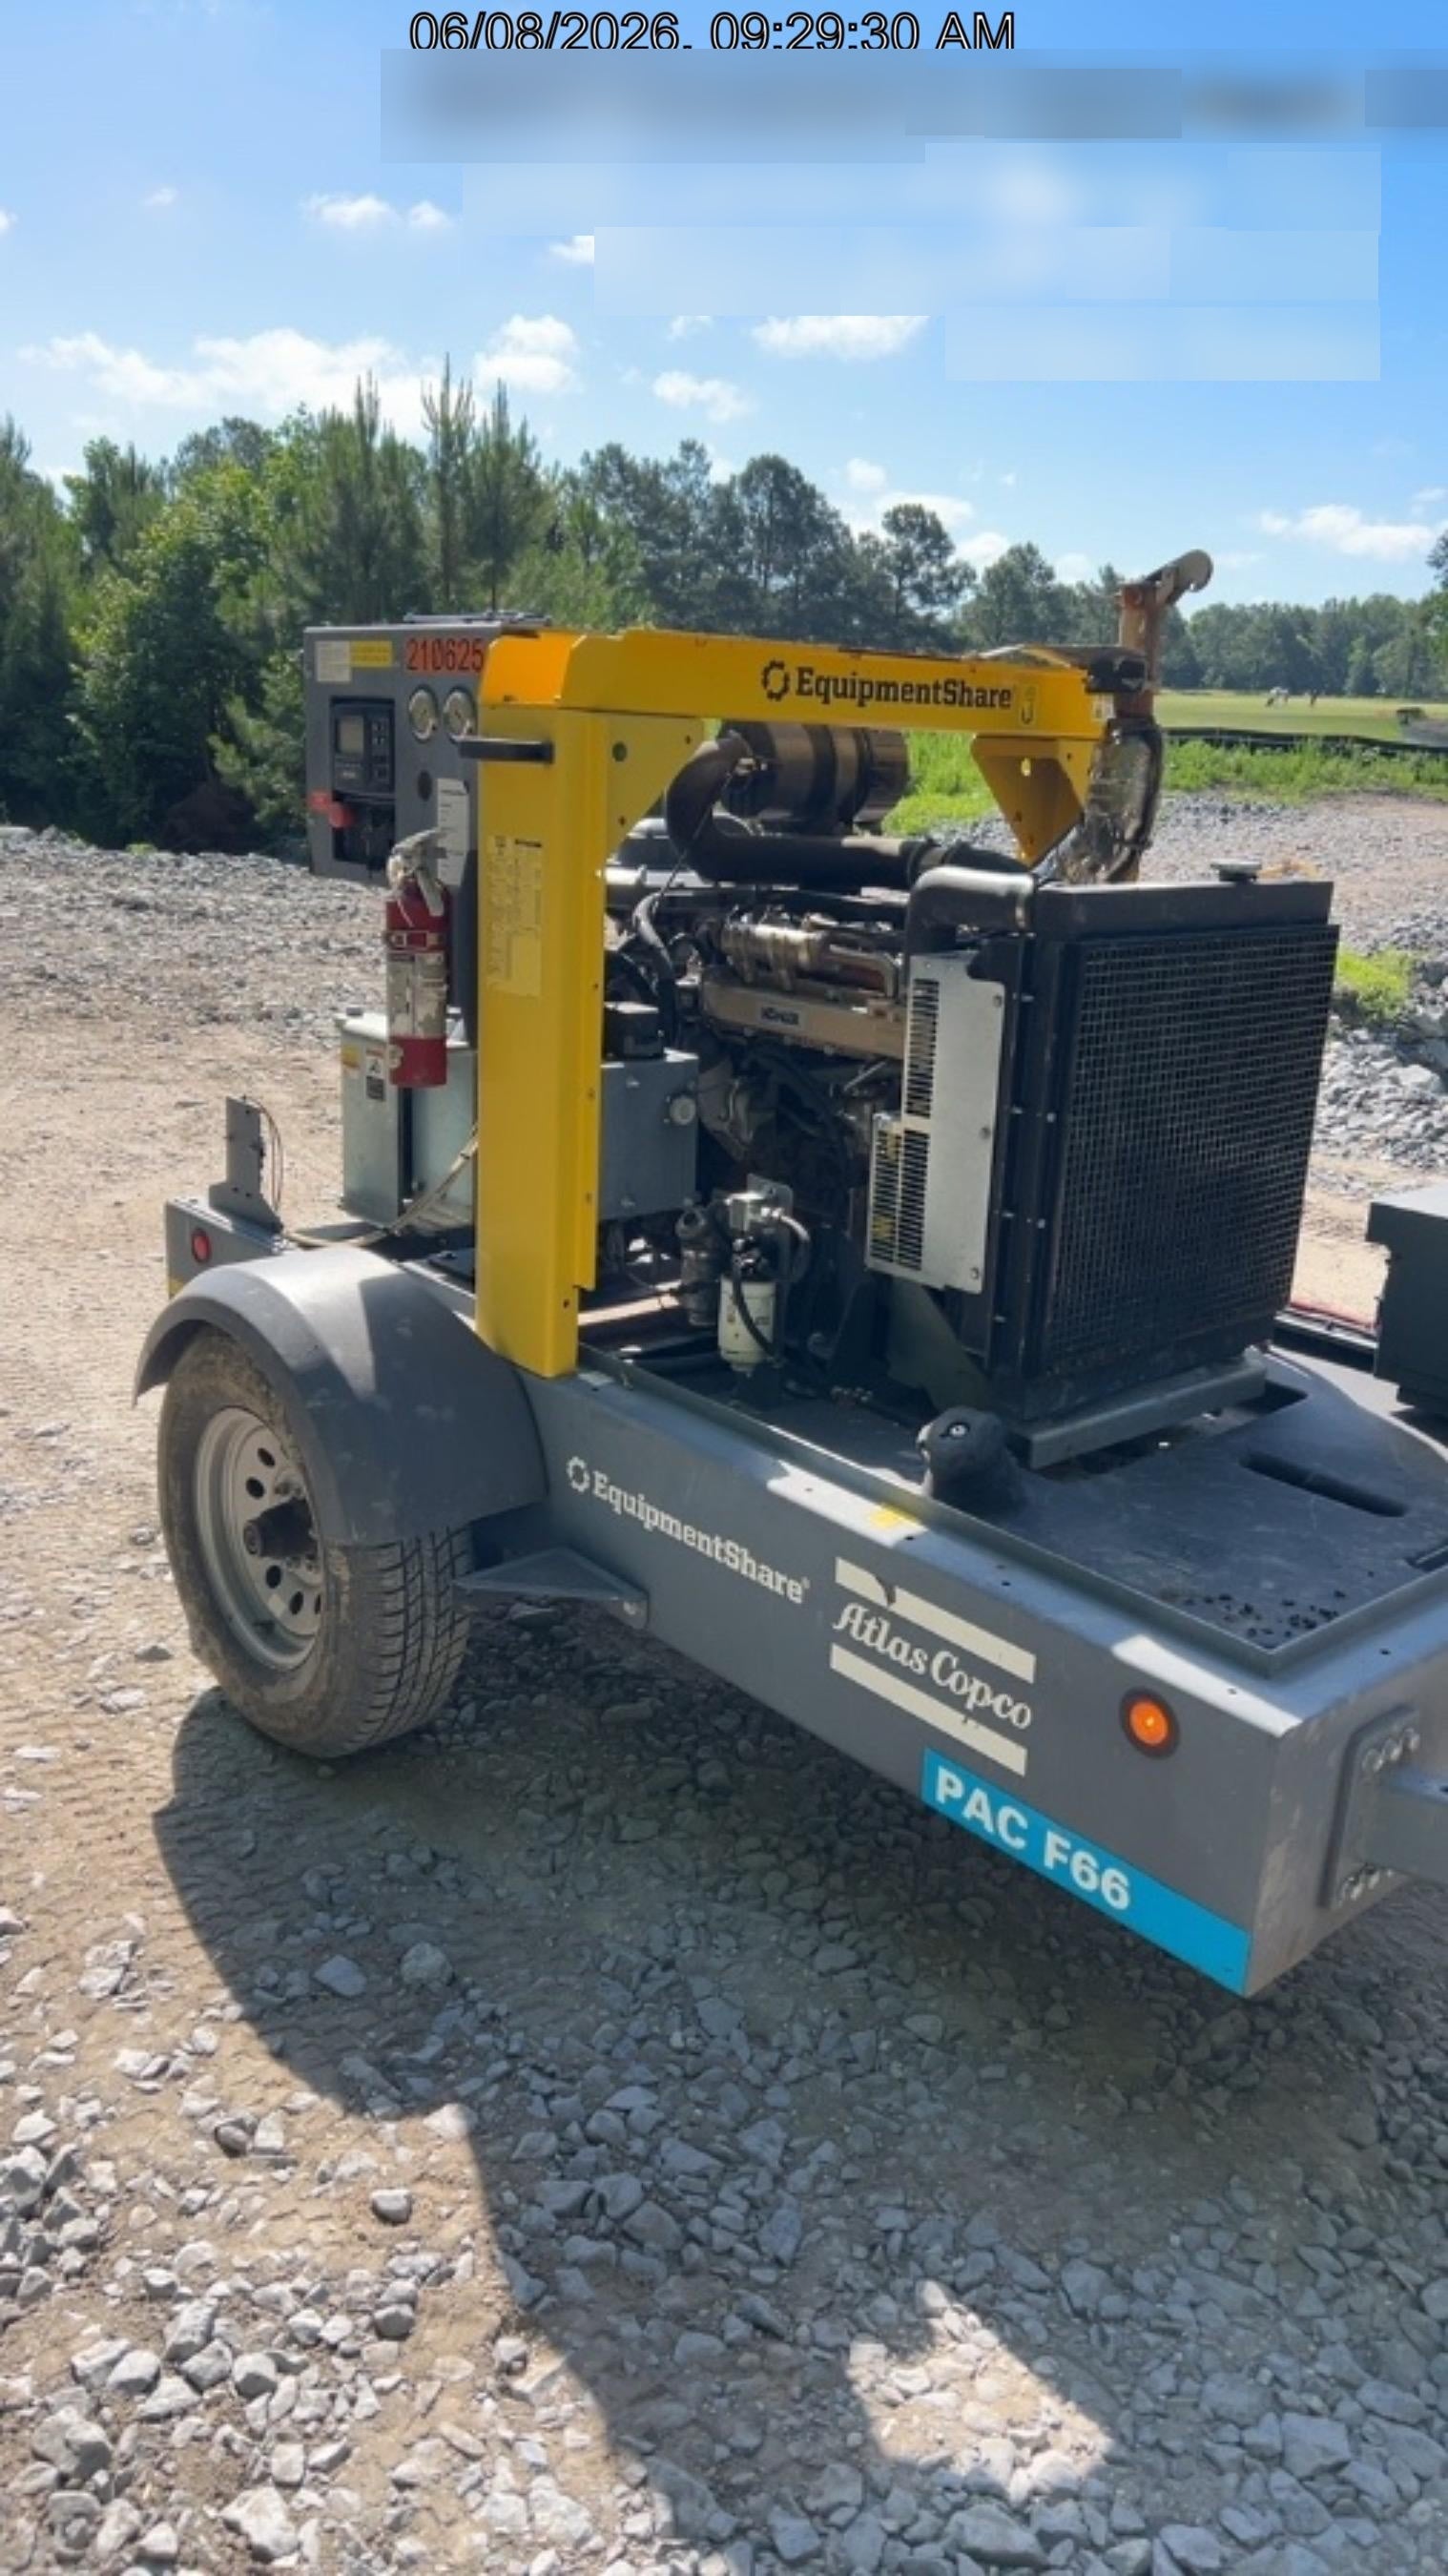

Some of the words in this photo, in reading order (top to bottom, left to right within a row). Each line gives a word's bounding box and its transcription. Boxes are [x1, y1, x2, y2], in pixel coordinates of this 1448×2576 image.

[406, 638, 484, 674] 210625
[796, 666, 1012, 709] EquipmentShare
[591, 1469, 804, 1604] EquipmentShare
[832, 1602, 928, 1675] Atlas
[931, 1650, 1032, 1729] Copco
[935, 1765, 1028, 1850] PAC
[1044, 1829, 1130, 1910] F66
